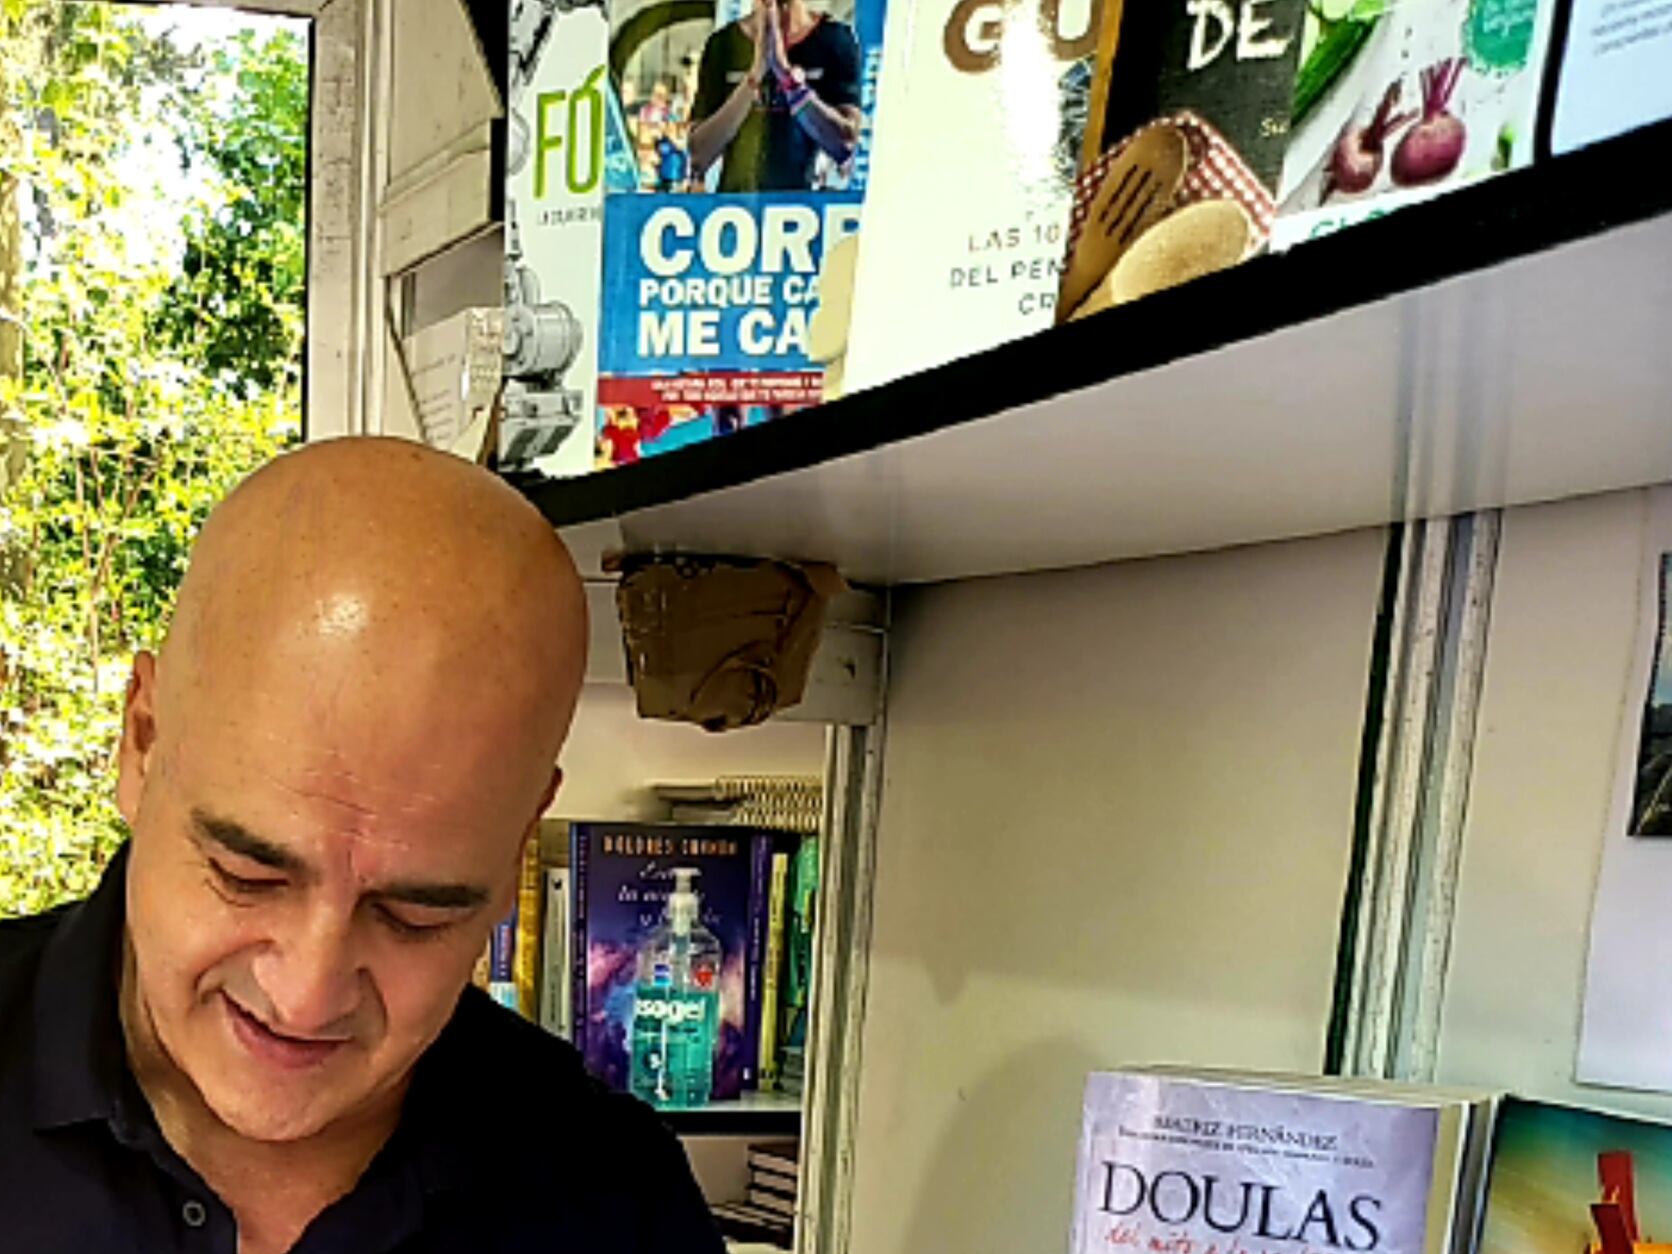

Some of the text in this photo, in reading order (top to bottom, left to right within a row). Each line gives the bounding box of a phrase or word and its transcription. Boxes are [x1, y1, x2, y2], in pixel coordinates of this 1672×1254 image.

[638, 277, 775, 310] PORQUE
[949, 265, 999, 290] DEL
[638, 309, 812, 357] ME CA
[1097, 1161, 1382, 1252] DOULAS
